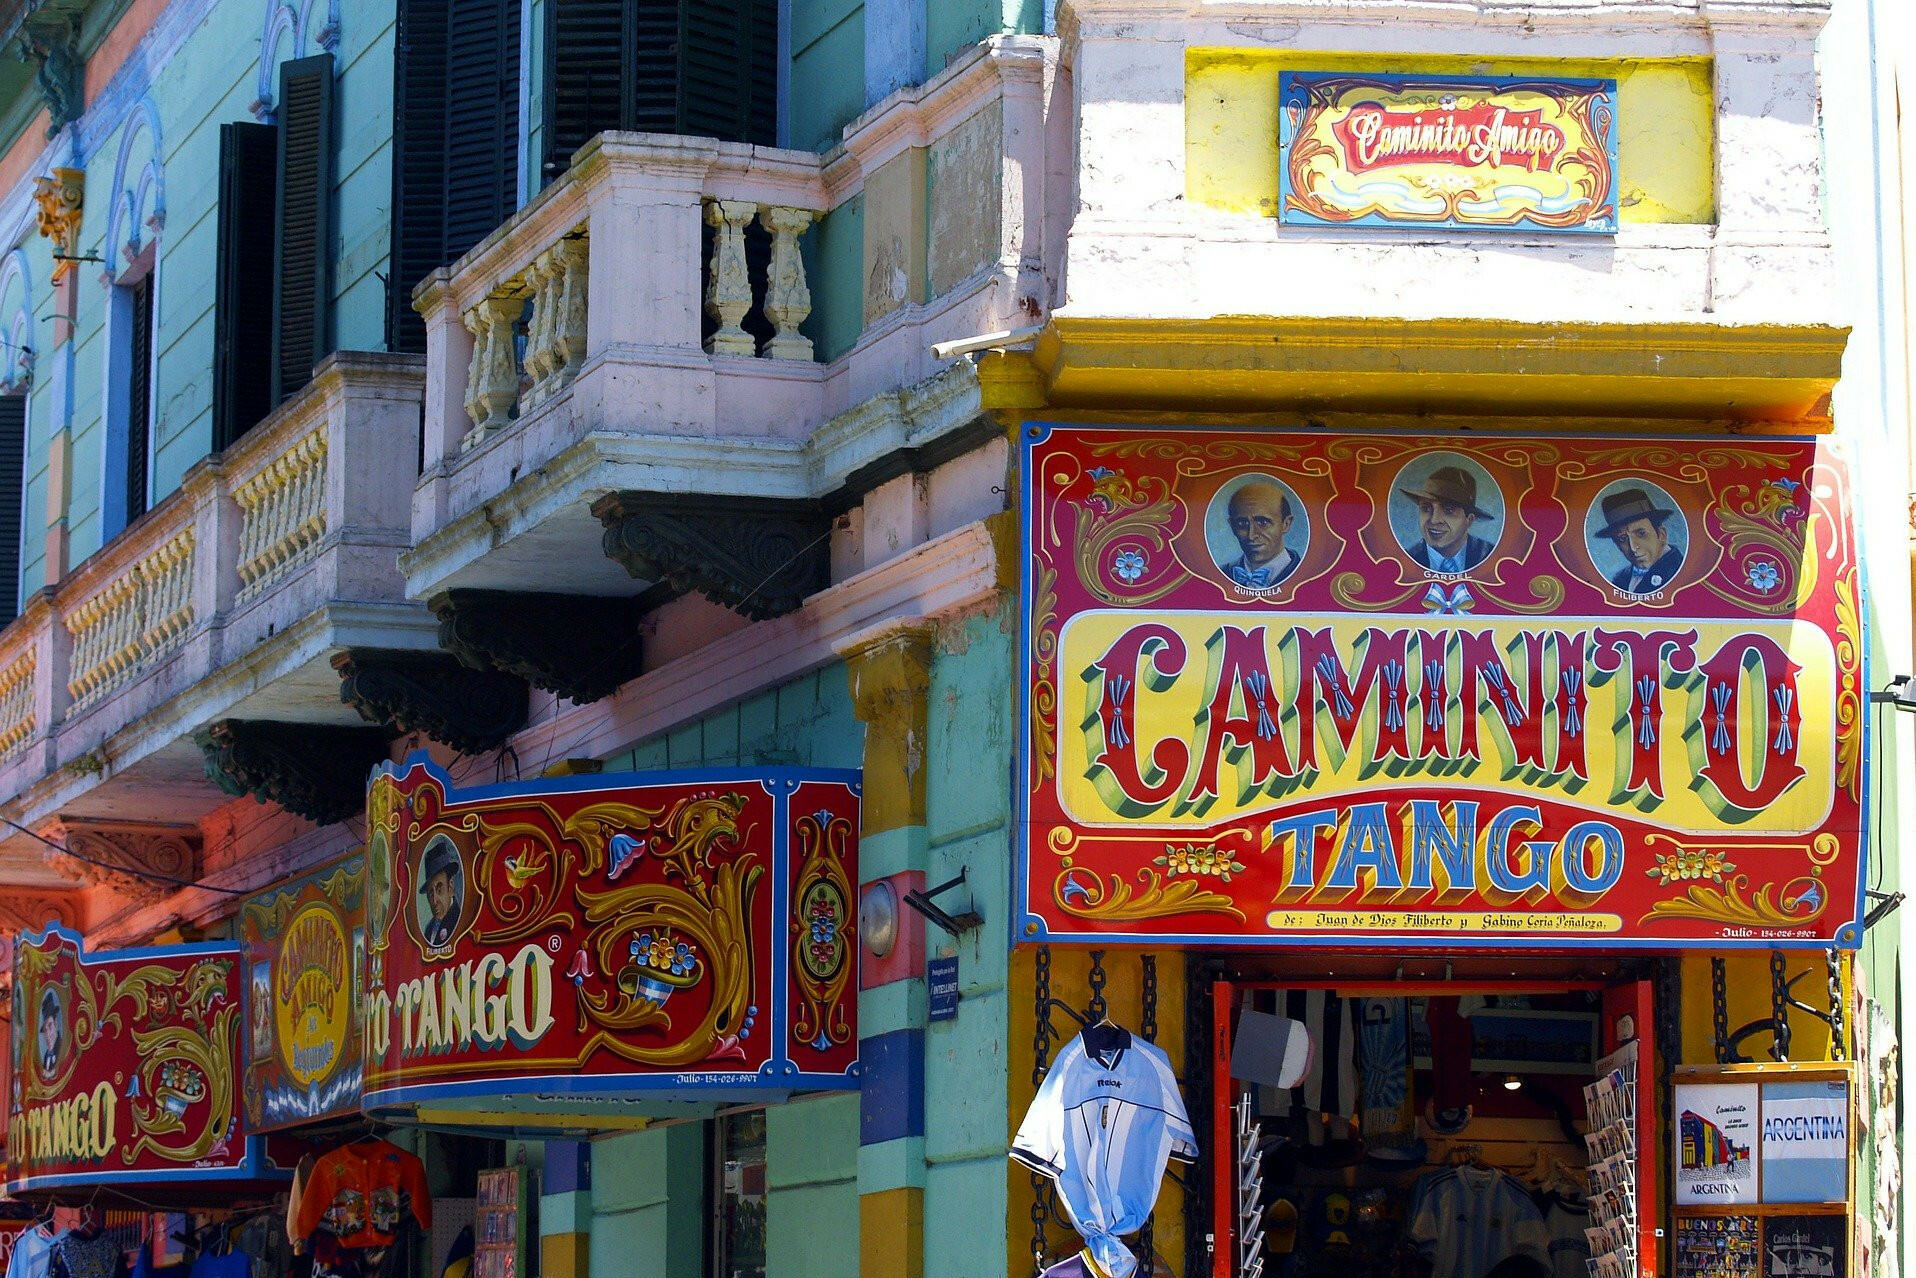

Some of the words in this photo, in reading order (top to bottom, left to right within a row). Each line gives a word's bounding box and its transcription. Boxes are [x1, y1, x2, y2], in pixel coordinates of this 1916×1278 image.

[1468, 109, 1559, 170] Amigo
[1423, 570, 1472, 581] GARDEL
[1234, 585, 1282, 597] QUINQUELA
[1613, 588, 1664, 602] FILIBERTO
[1080, 622, 1807, 822] CAMINITO
[1262, 800, 1625, 908] TANGO
[1316, 913, 1348, 928] Juan
[1352, 913, 1364, 926] de
[1369, 914, 1397, 927] Dios
[1403, 913, 1453, 927] Filiberto
[1460, 918, 1468, 930] y
[1482, 914, 1523, 929] Gabino
[1527, 914, 1553, 928] Coria
[395, 943, 556, 1053] TANGO
[28, 1080, 118, 1162] TANGO
[1763, 1116, 1845, 1142] ARGENTINA
[1678, 1218, 1723, 1232] BUENOS
